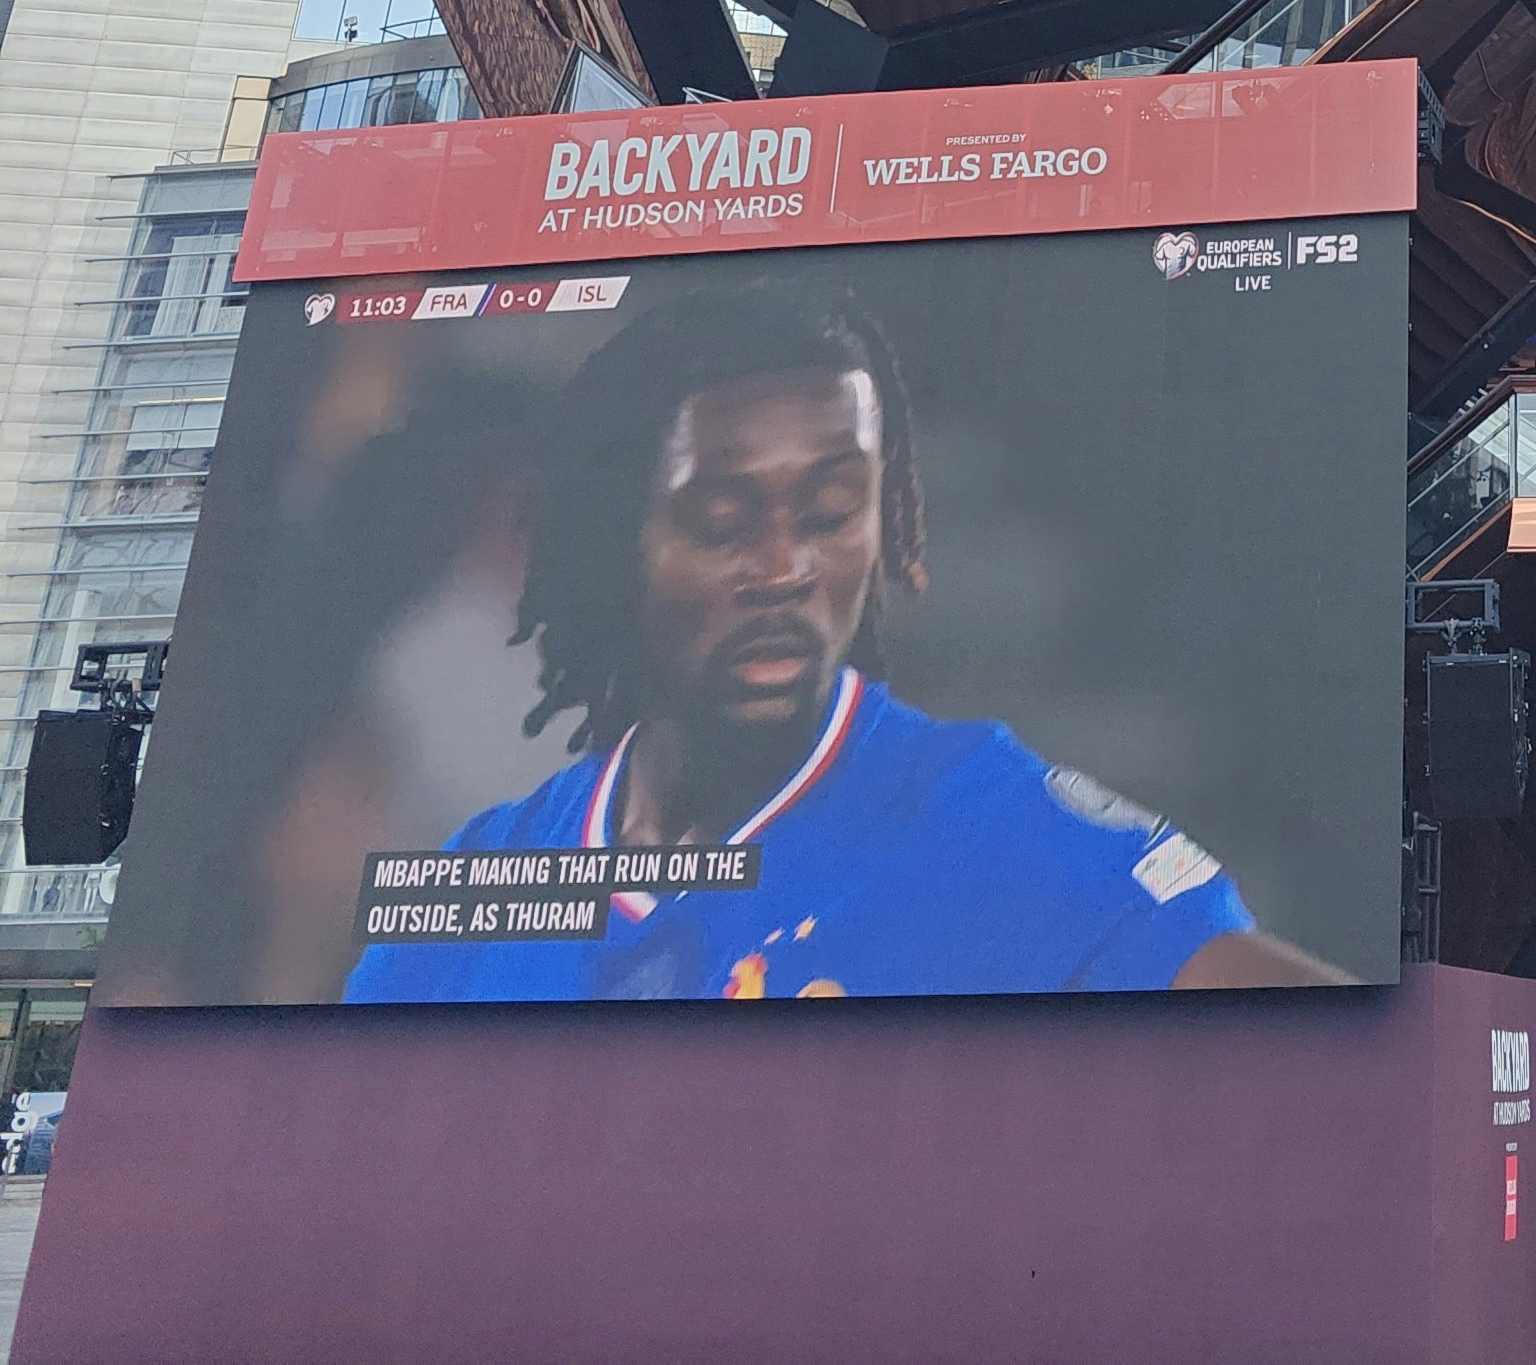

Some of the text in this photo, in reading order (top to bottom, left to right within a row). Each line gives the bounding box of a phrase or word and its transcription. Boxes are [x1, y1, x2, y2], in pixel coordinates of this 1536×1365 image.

[945, 133, 1027, 146] PRESENTED BY
[544, 127, 812, 201] BACKYARD
[863, 147, 1108, 186] WELLS FARGO
[537, 193, 804, 234] AT HUDSON YARDS
[1197, 251, 1282, 272] QUALIFIERS
[1206, 238, 1274, 254] EUROPEAN
[1296, 234, 1358, 265] FS2
[350, 282, 607, 318] 11:03 FRA 0-0 ISL
[1235, 275, 1272, 292] LIVE
[374, 851, 746, 888] MBAPPE MAKING THAT RUN ON THE
[367, 901, 596, 936] OUTSIDE, AS THURAM
[1491, 1029, 1530, 1093] BACKYARD
